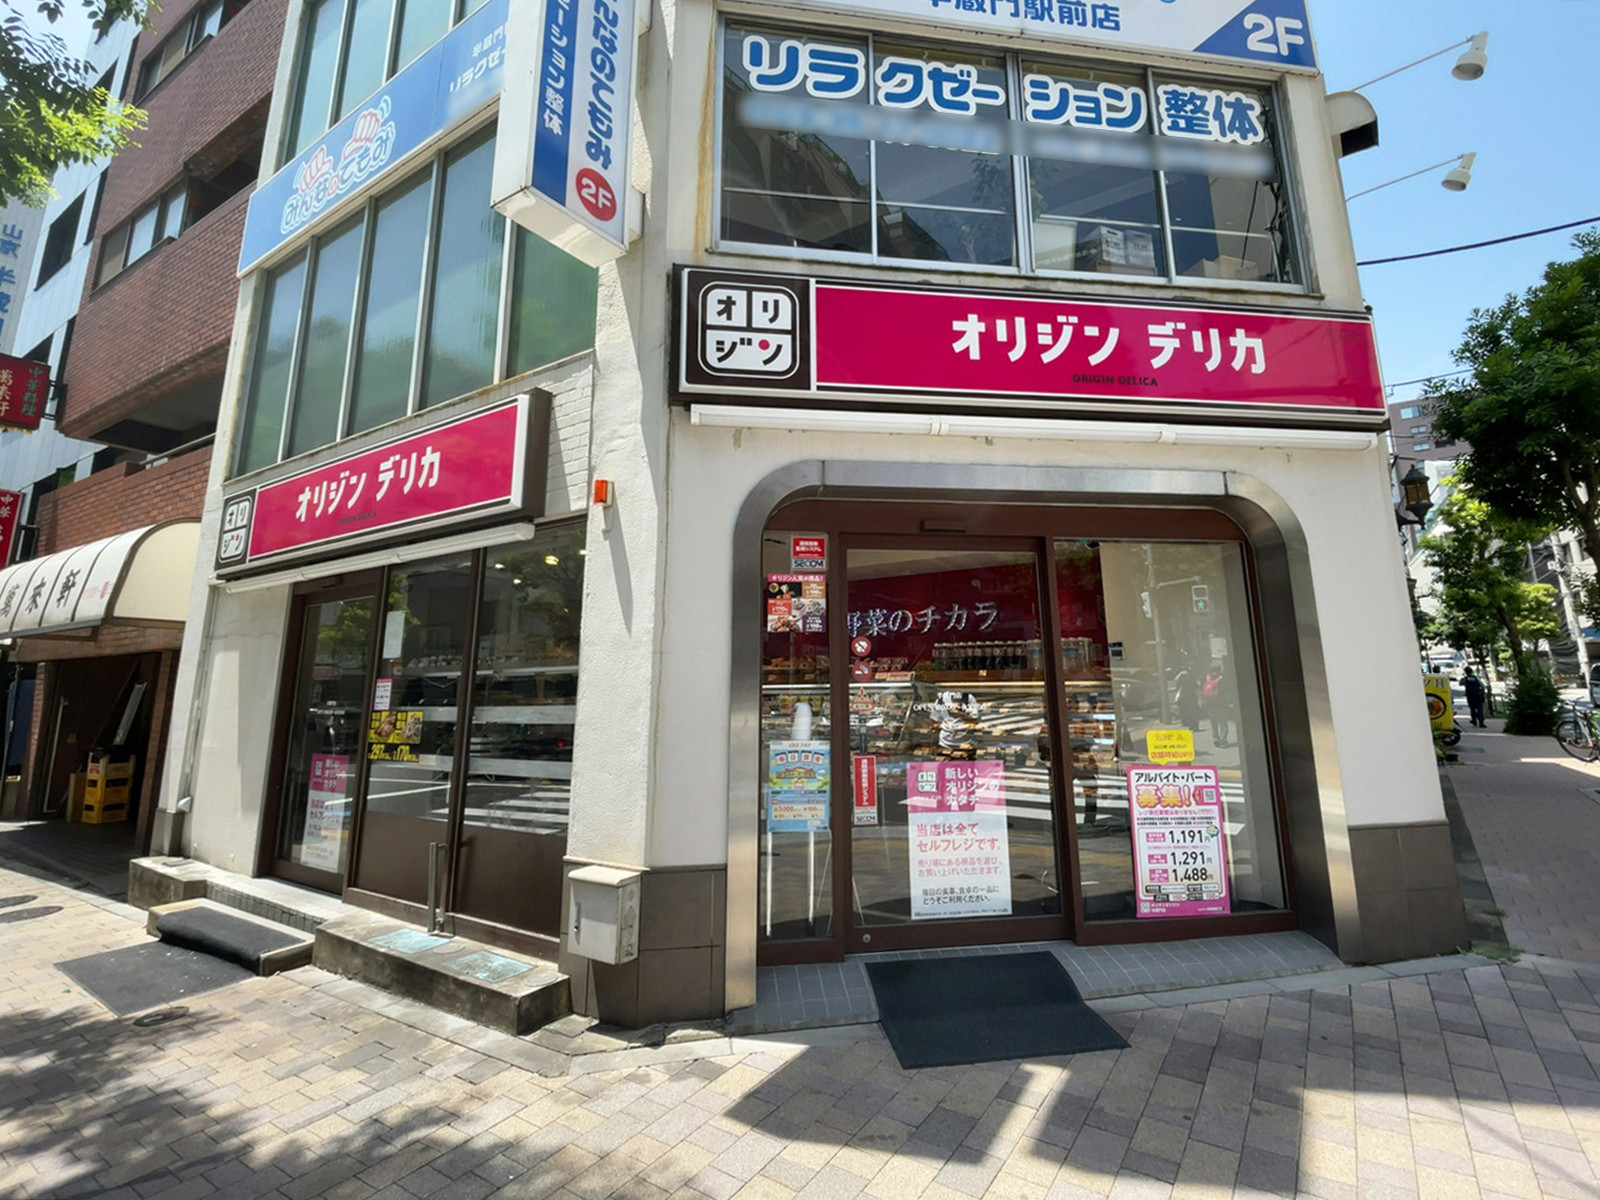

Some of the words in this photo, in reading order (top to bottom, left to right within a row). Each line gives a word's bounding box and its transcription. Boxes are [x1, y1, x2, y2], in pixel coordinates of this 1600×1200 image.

[930, 0, 1121, 32] 門駅前店
[472, 22, 507, 57] 半蔵門
[1243, 12, 1305, 57] 2F
[449, 46, 505, 92] リラクゼ
[585, 0, 618, 170] んなのてもみ
[580, 176, 613, 209] 2F
[951, 313, 1120, 367] オリジン
[1147, 321, 1266, 375] デリカ
[1072, 374, 1114, 384] ORIGIN
[1118, 376, 1158, 386] DELICA
[296, 470, 367, 522] オリジン
[376, 446, 441, 502] デリカ
[794, 559, 823, 568] SECOM
[945, 767, 979, 780] 新しい
[1135, 771, 1212, 783] アルバイト・パート
[917, 823, 979, 838] 当店は全て
[917, 838, 1001, 853] セルフレジです。
